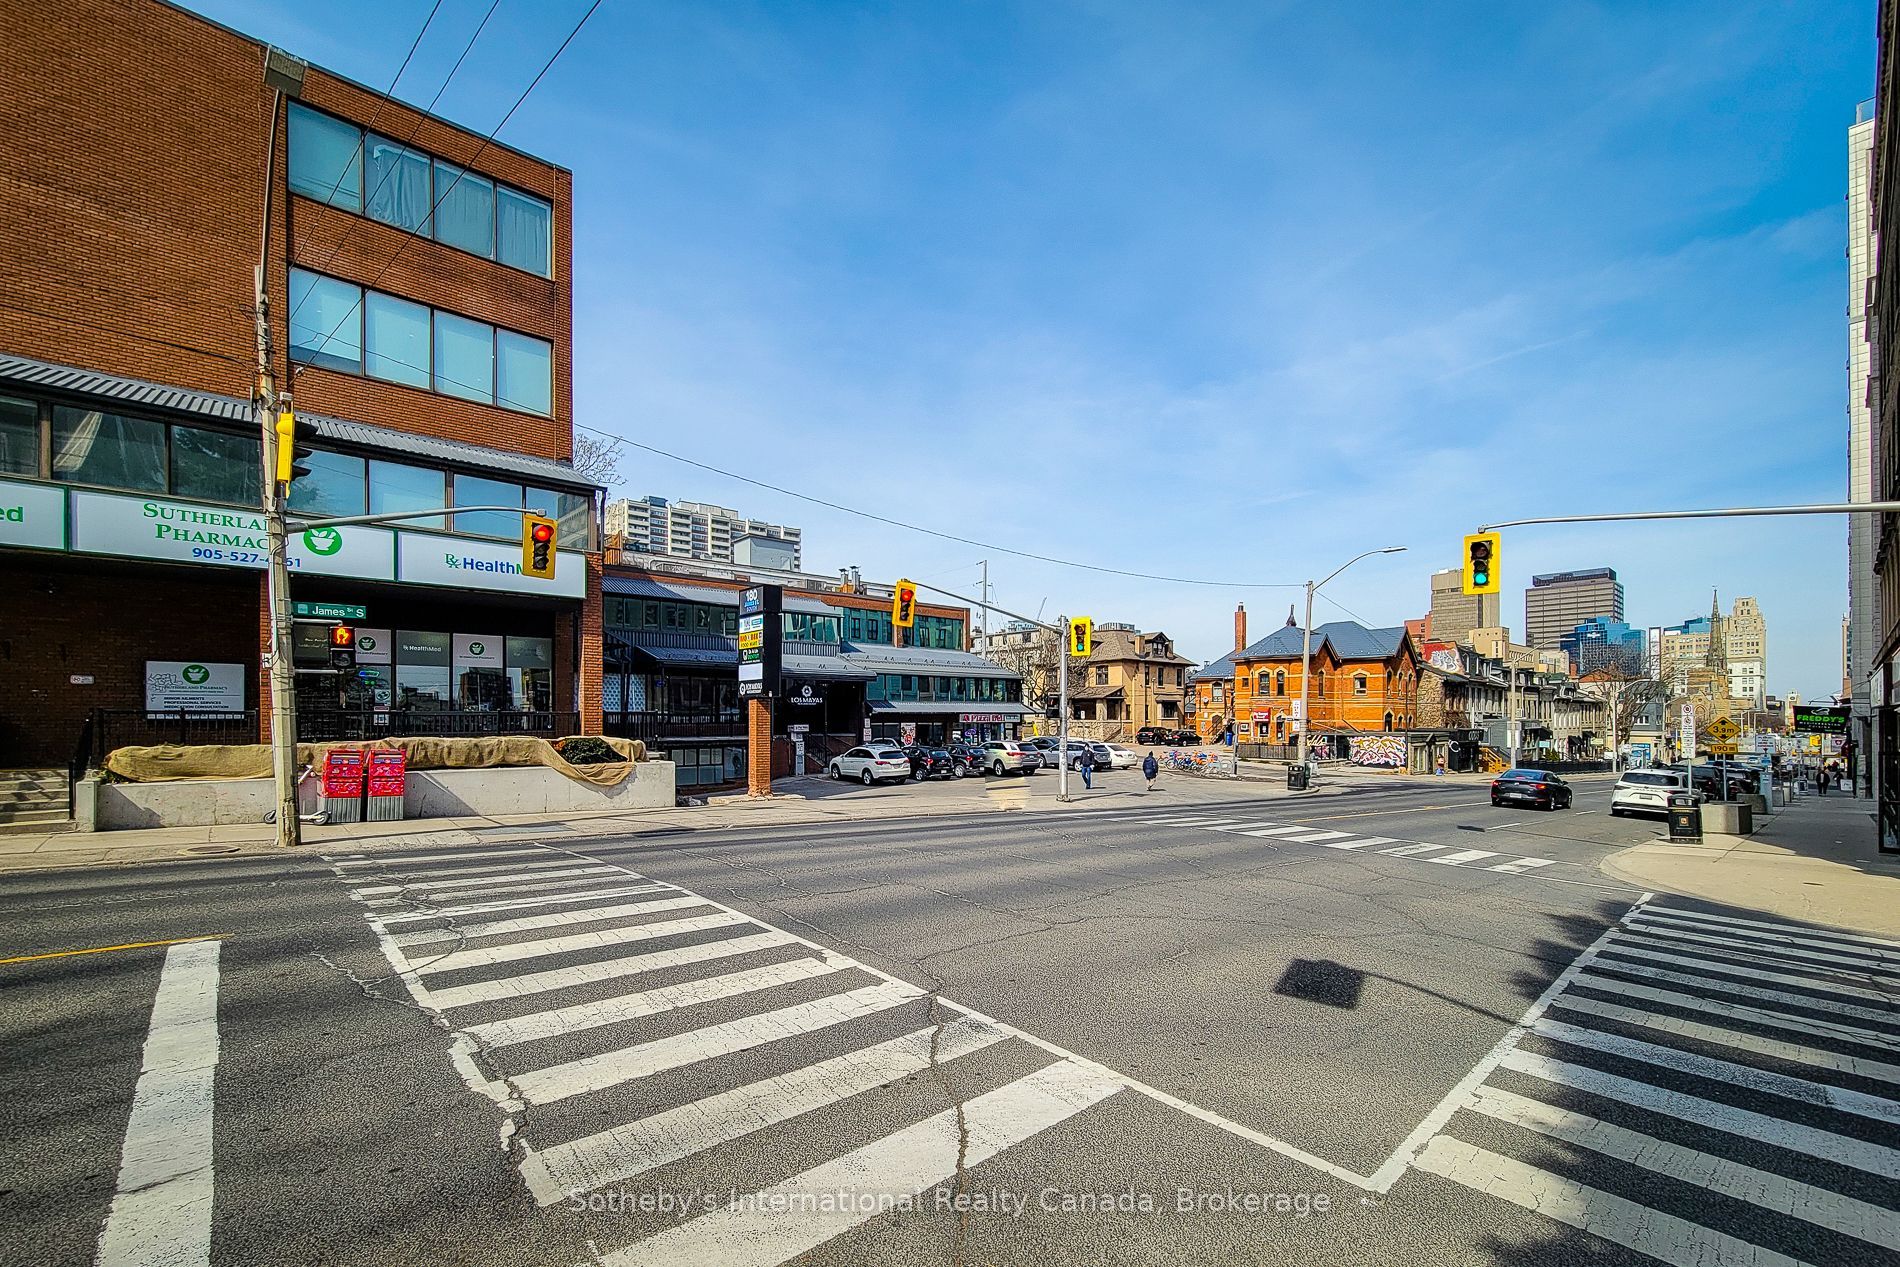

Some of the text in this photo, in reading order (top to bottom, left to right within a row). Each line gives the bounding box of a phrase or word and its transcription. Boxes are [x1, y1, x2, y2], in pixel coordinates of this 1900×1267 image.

[143, 502, 269, 531] SUTHERLA
[155, 523, 270, 549] PHARMAC
[192, 547, 302, 568] 905-527-61
[463, 557, 523, 574] Health
[312, 606, 346, 617] James
[356, 608, 364, 618] S
[1796, 714, 1845, 723] FREDDY'S
